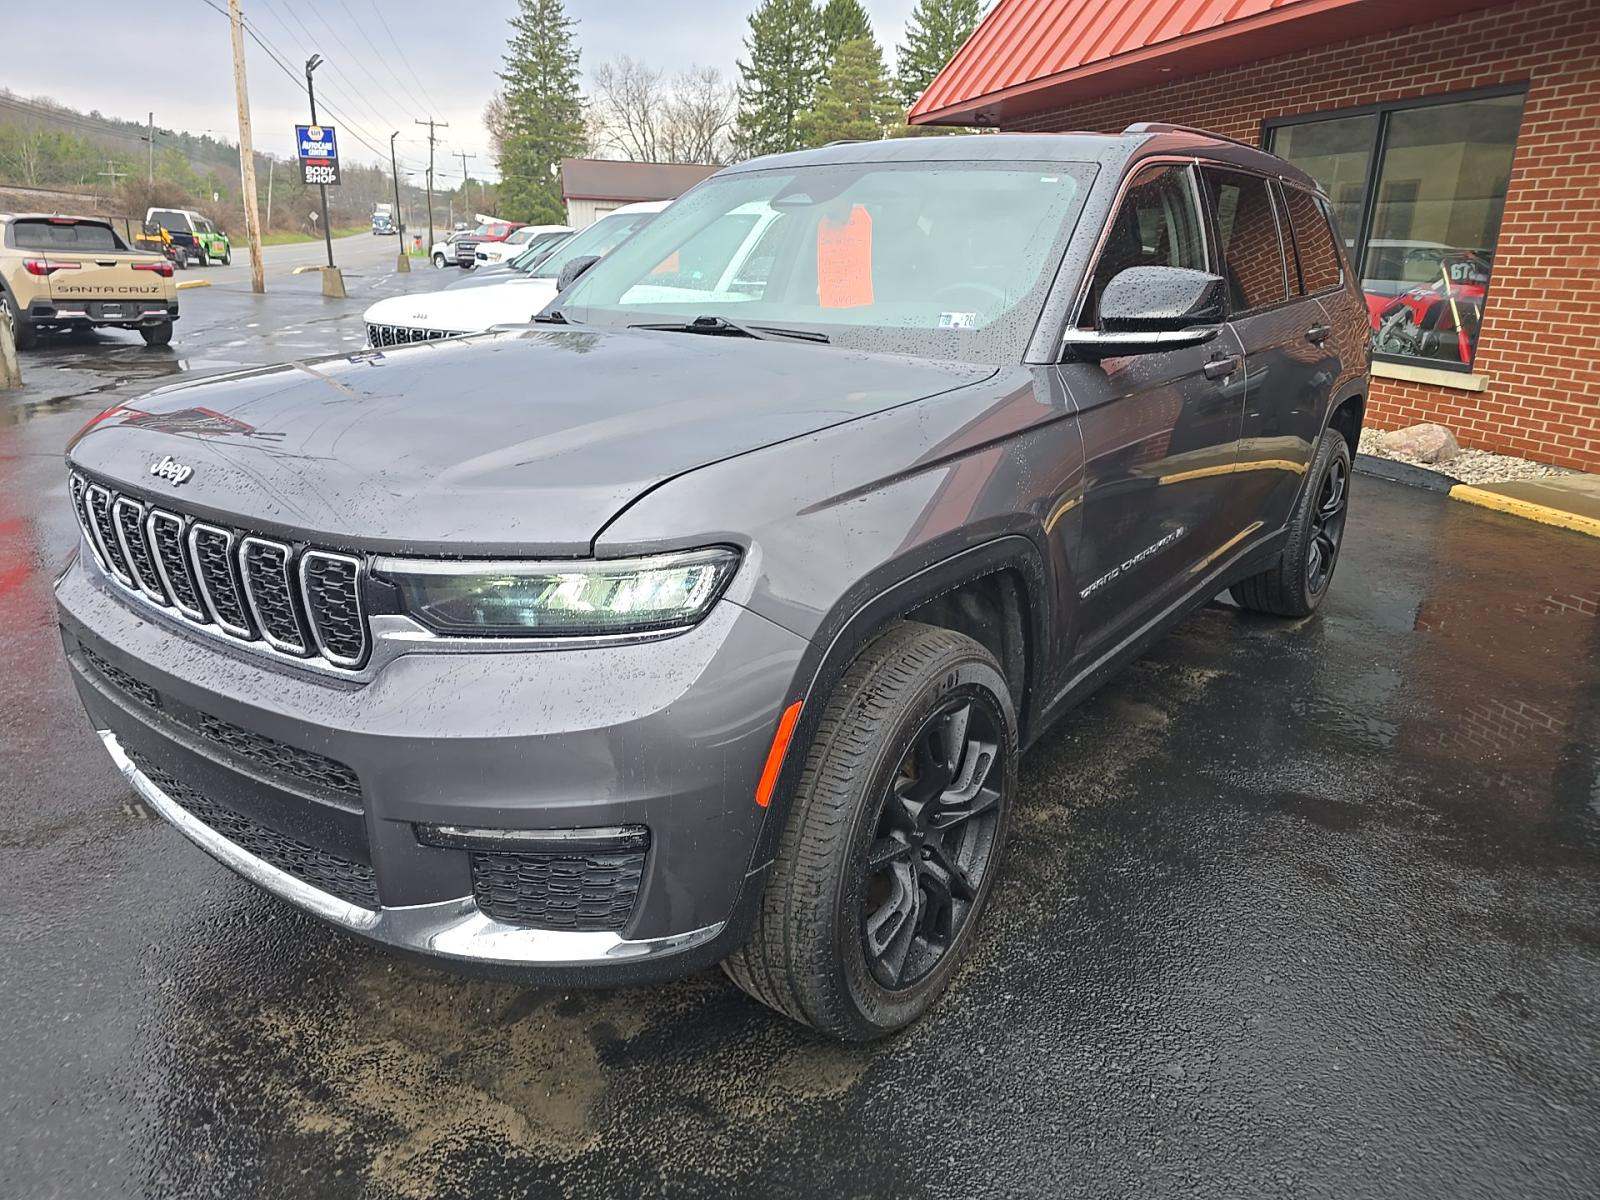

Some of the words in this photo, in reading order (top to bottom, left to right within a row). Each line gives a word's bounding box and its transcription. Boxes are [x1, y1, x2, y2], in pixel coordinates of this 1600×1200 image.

[305, 166, 335, 175] BODY
[305, 174, 336, 184] SHOP
[150, 455, 192, 485] Jeep
[1079, 567, 1120, 598] GRAND
[1120, 532, 1176, 570] CHEROKEE
